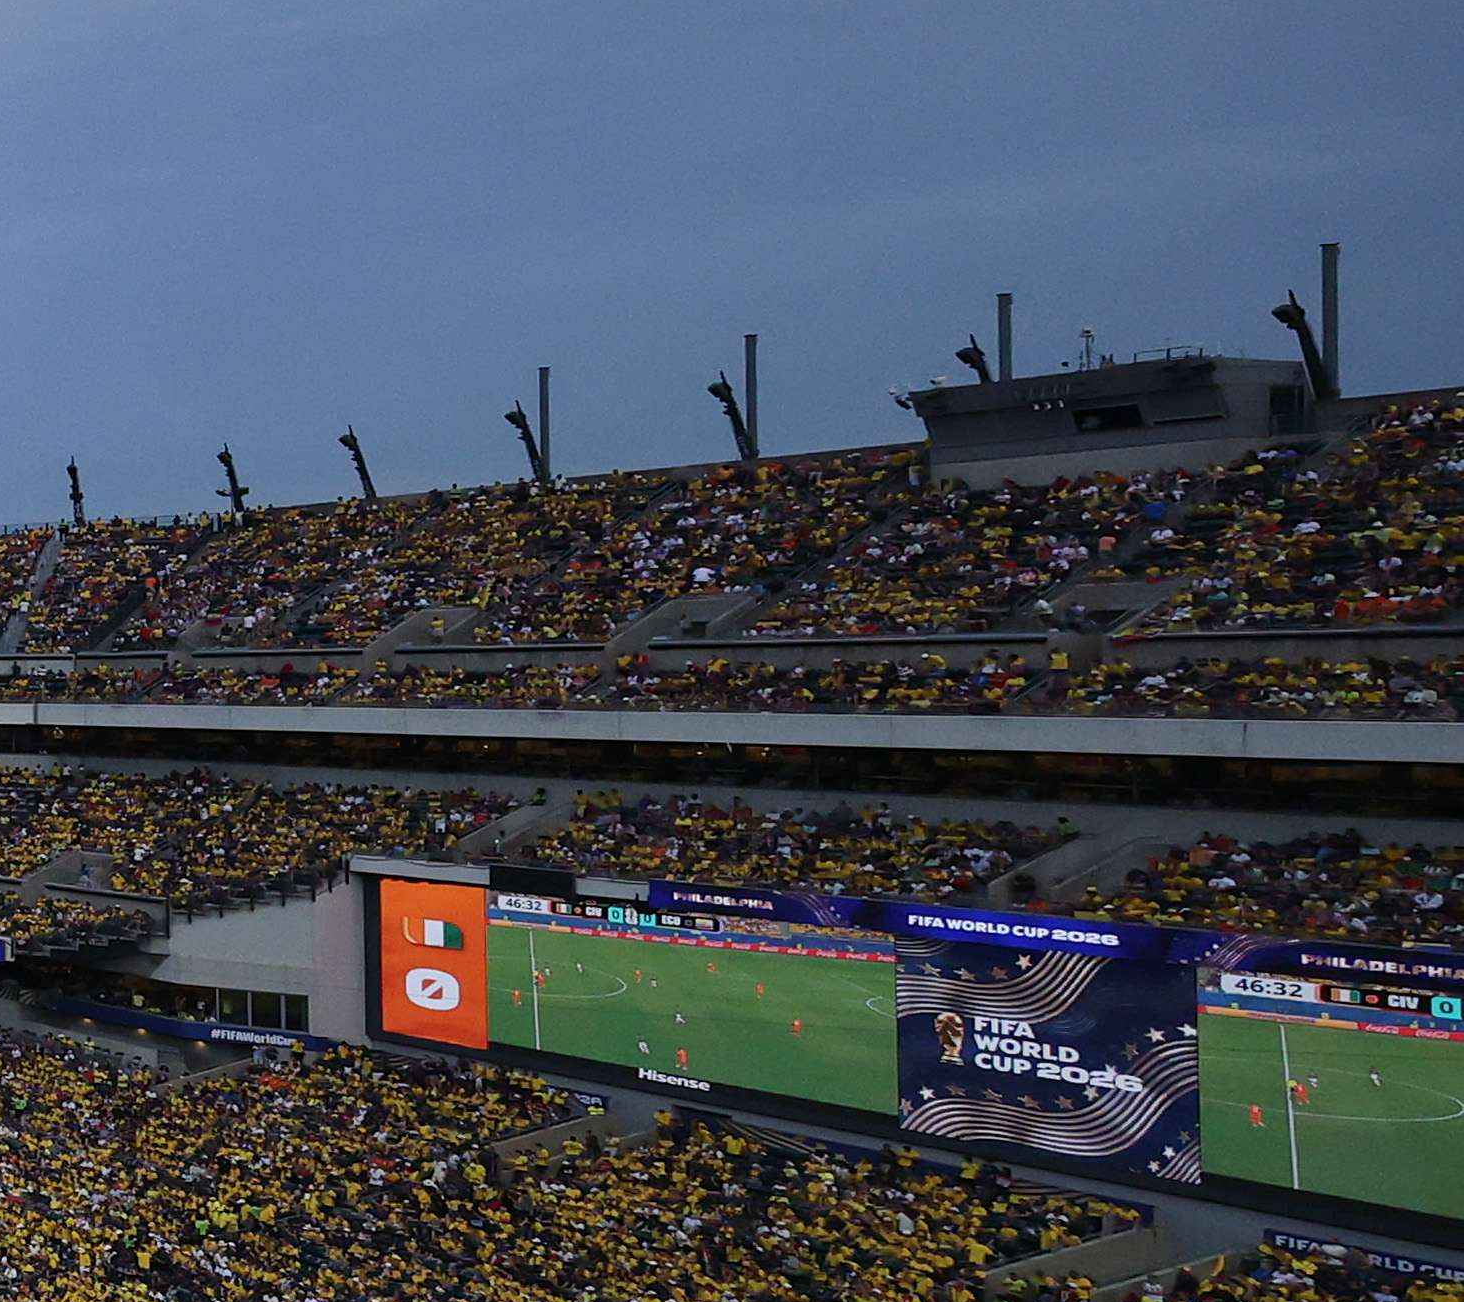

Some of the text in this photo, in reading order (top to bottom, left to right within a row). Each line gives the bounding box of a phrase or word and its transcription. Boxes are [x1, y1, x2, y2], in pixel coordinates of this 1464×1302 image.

[505, 897, 543, 911] 46:32
[673, 891, 774, 911] PHILADELPHIA
[908, 914, 1120, 947] FIFA WORLD CUP 2026
[1234, 977, 1303, 998] 46:32
[1387, 994, 1419, 1009] CIV
[974, 1017, 1036, 1039] FIFA
[973, 1033, 1081, 1064] WORLD
[638, 1067, 711, 1092] Hisense
[974, 1053, 1144, 1093] CUP 2026
[1275, 1235, 1322, 1253] FIFA
